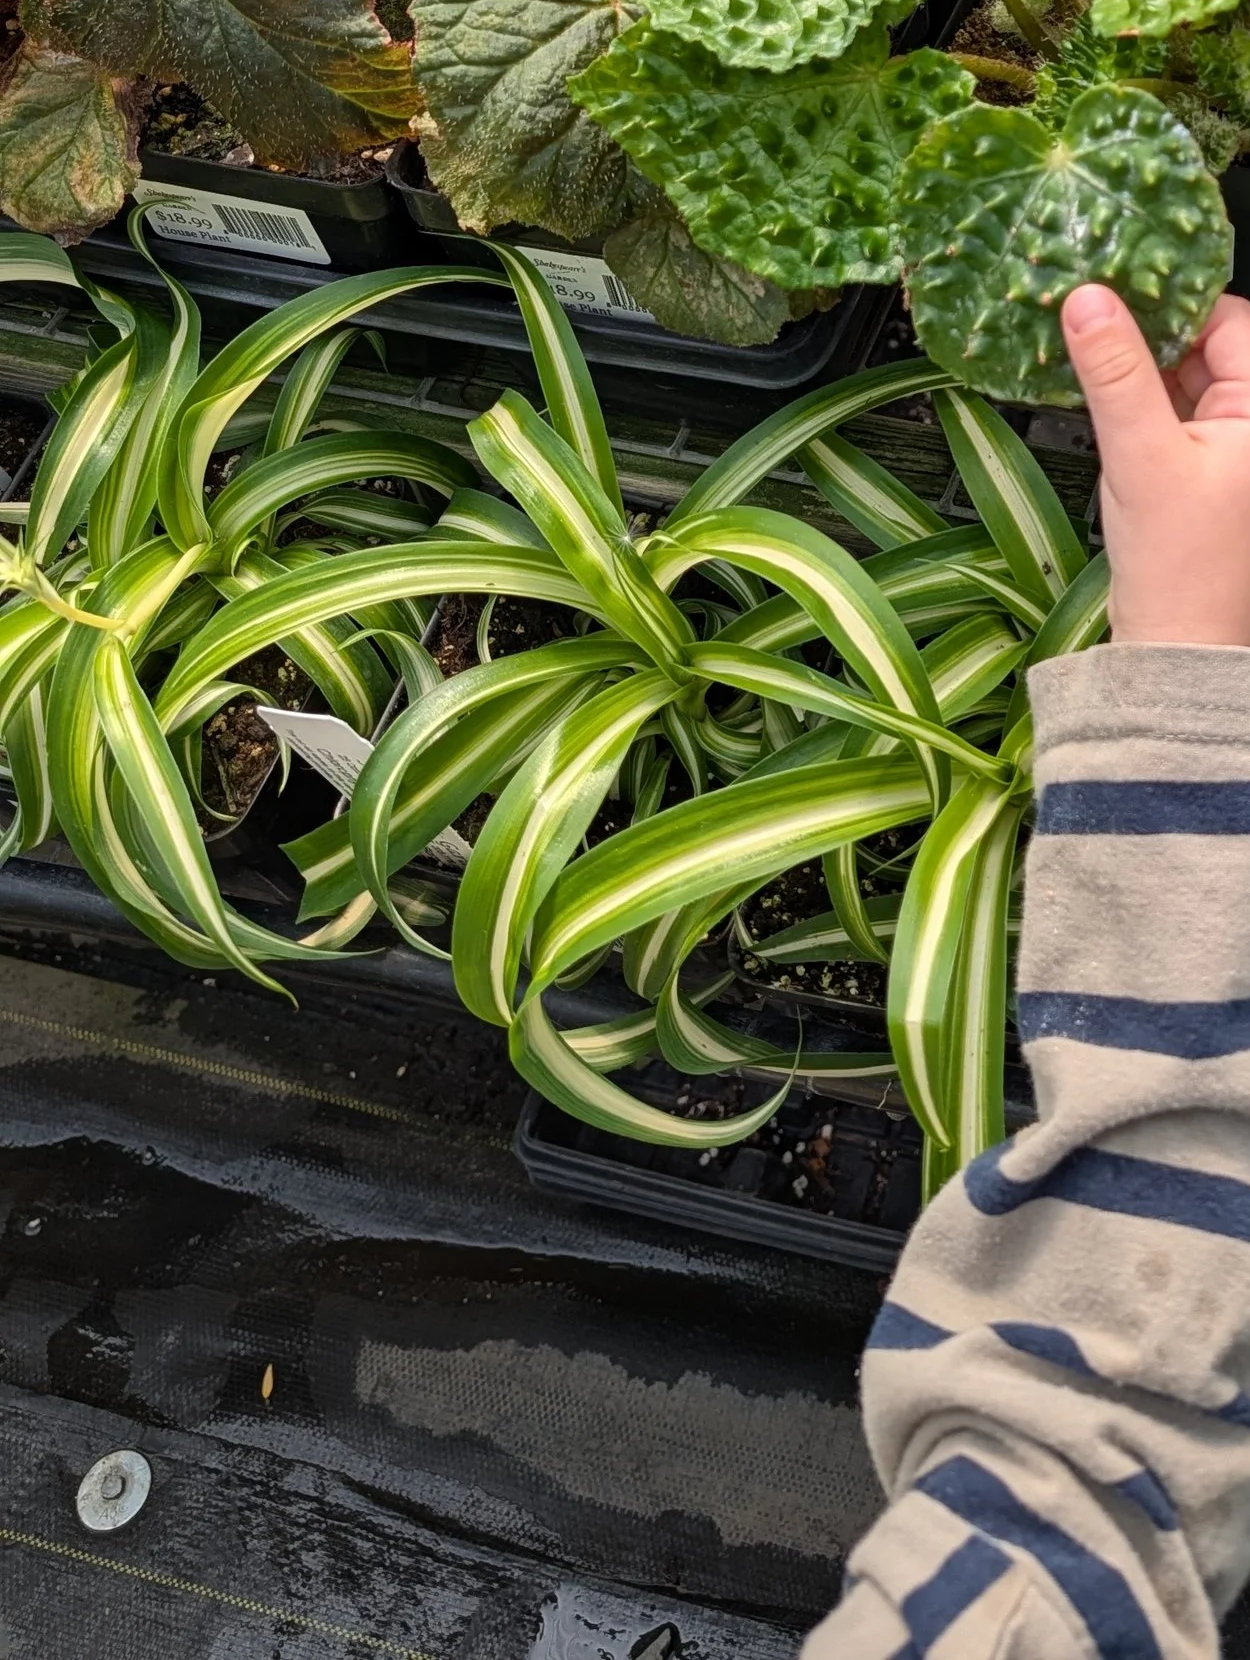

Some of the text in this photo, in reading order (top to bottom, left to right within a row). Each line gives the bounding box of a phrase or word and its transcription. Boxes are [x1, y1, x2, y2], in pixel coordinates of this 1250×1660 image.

[155, 210, 213, 230] $18.99
[158, 225, 232, 243] House Plant
[550, 284, 596, 302] 18.99
[579, 302, 613, 317] Plant
